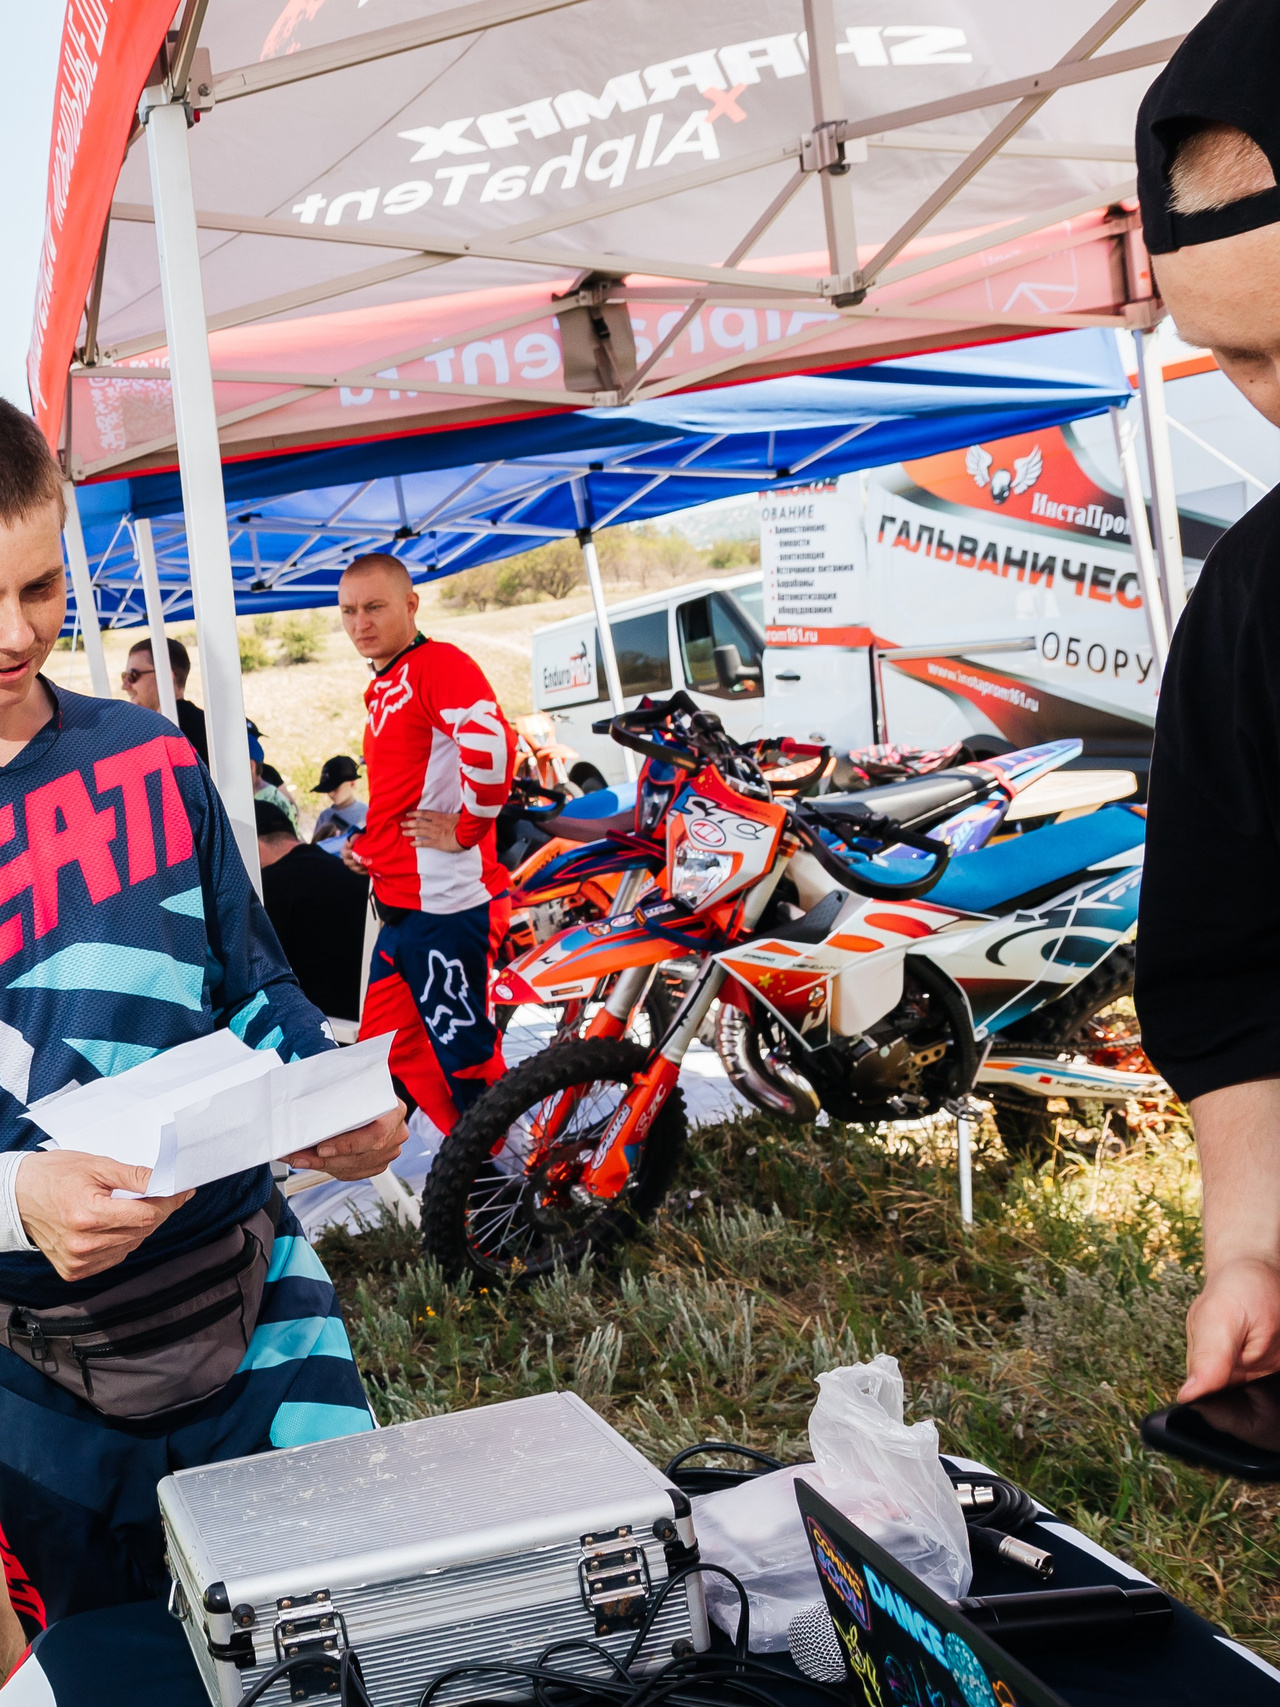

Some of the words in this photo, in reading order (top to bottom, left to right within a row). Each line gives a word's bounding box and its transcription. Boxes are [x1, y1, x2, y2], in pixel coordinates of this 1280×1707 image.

[762, 504, 815, 521] ОВАНИЕ
[813, 1528, 862, 1600] COMING
[816, 1543, 866, 1623] SOON
[863, 1564, 950, 1670] DANCE
